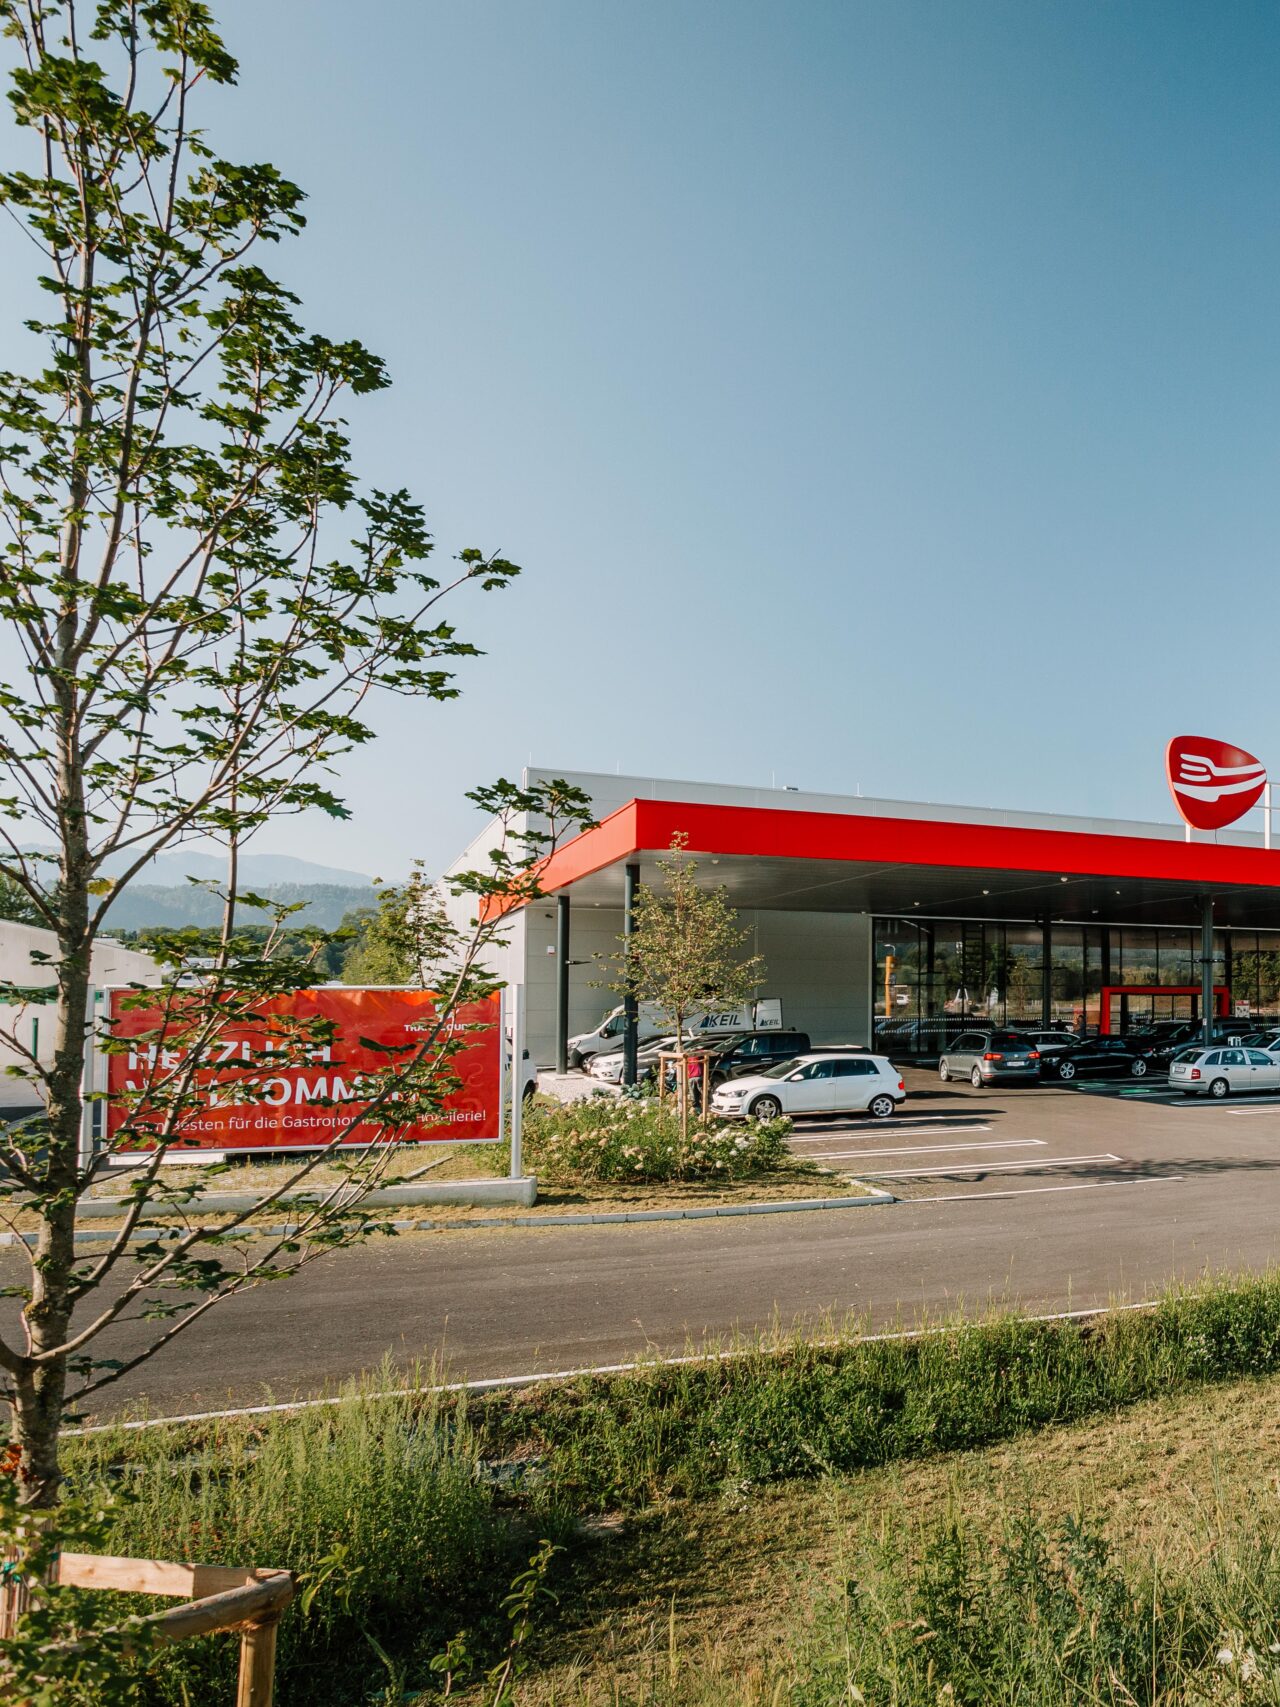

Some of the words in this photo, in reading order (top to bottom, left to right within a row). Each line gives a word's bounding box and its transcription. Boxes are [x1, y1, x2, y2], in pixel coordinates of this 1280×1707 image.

[708, 1014, 741, 1026] KEIL
[229, 1116, 251, 1129] für
[254, 1116, 278, 1129] die
[282, 1115, 379, 1128] Gastrono
